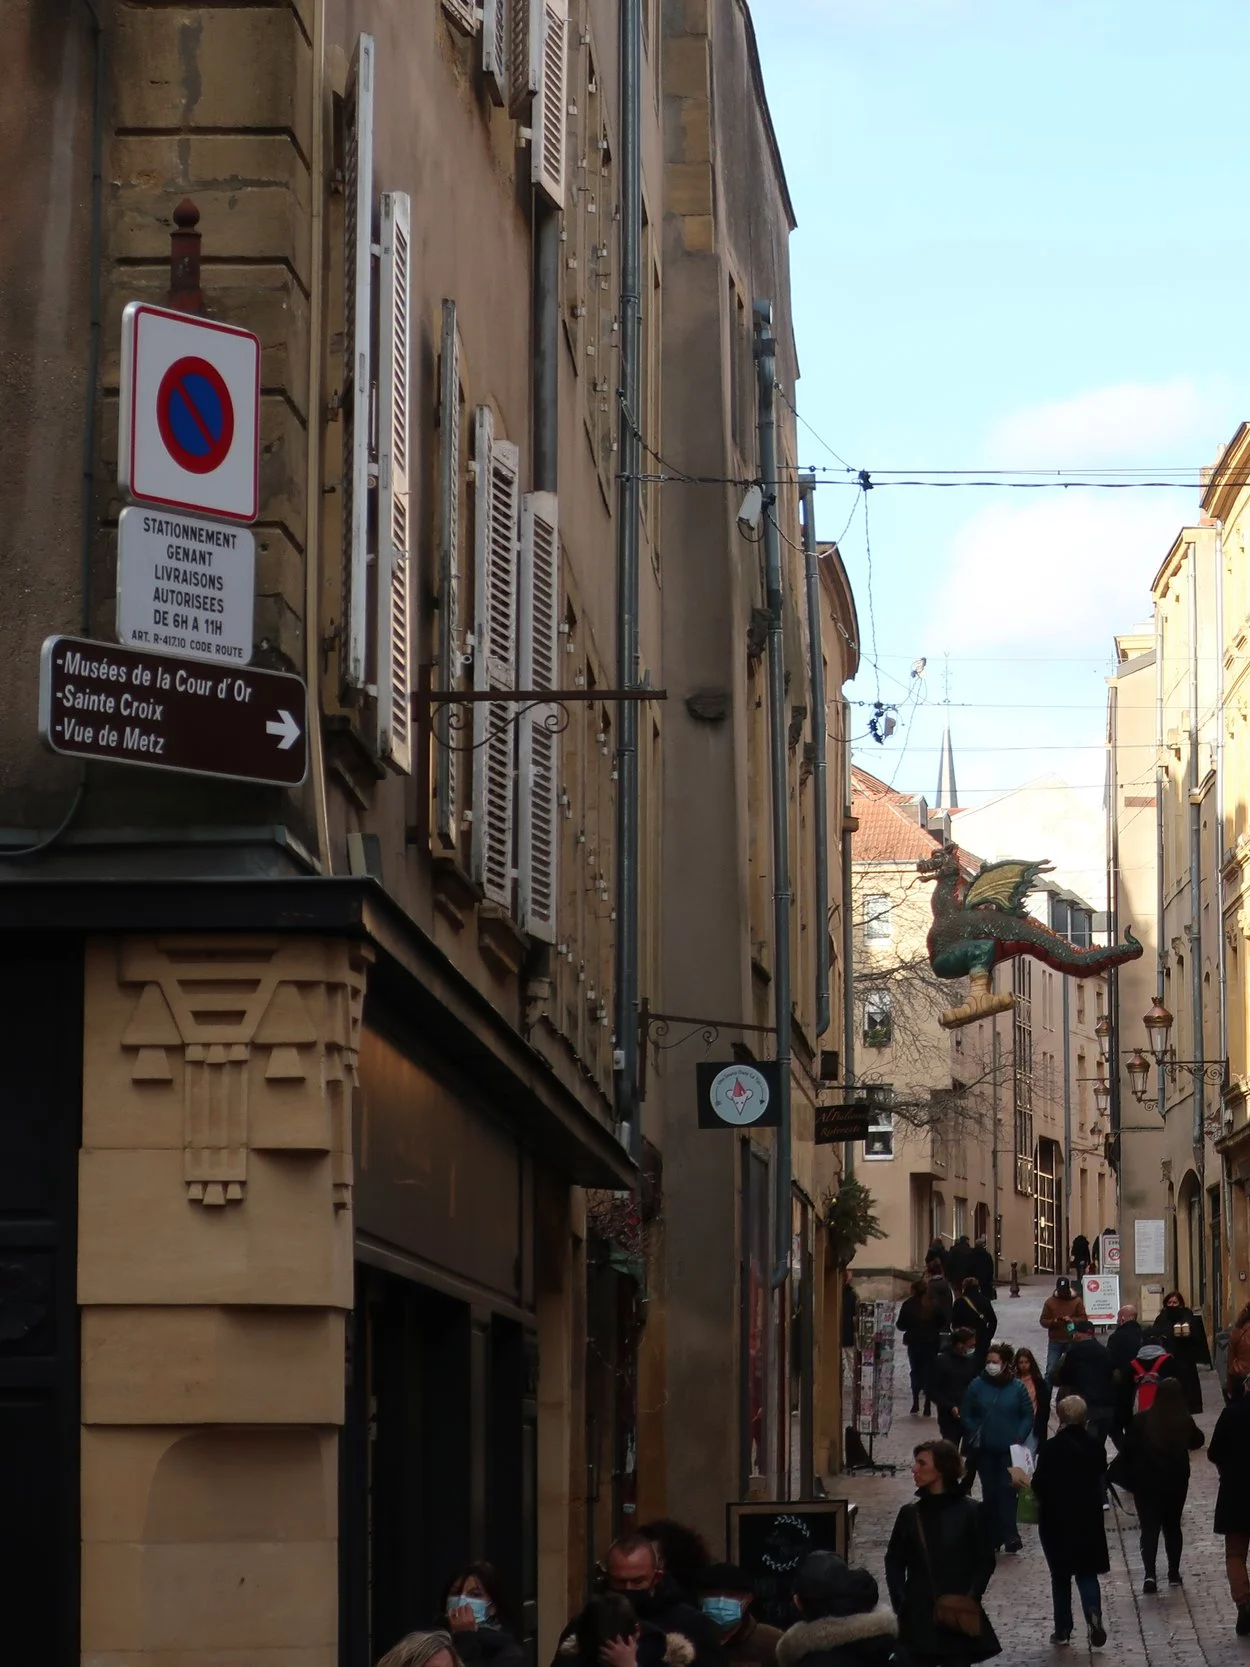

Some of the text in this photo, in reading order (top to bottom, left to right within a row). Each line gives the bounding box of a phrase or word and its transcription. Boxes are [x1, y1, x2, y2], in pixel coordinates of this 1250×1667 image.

[143, 517, 237, 549] STATIONNEMENT
[167, 544, 213, 567] GENANT
[154, 564, 224, 591] LIVRAISONS
[153, 587, 224, 614] AUTORISEES
[153, 610, 222, 636] DE 6H A 11H
[131, 630, 150, 642] ART.
[190, 640, 212, 653] CODE
[215, 645, 243, 658] ROUTE
[132, 664, 151, 686] de
[156, 666, 170, 690] la
[175, 670, 212, 696] Cour
[120, 693, 163, 721] Croix
[98, 724, 118, 748] de
[123, 726, 165, 754] Metz
